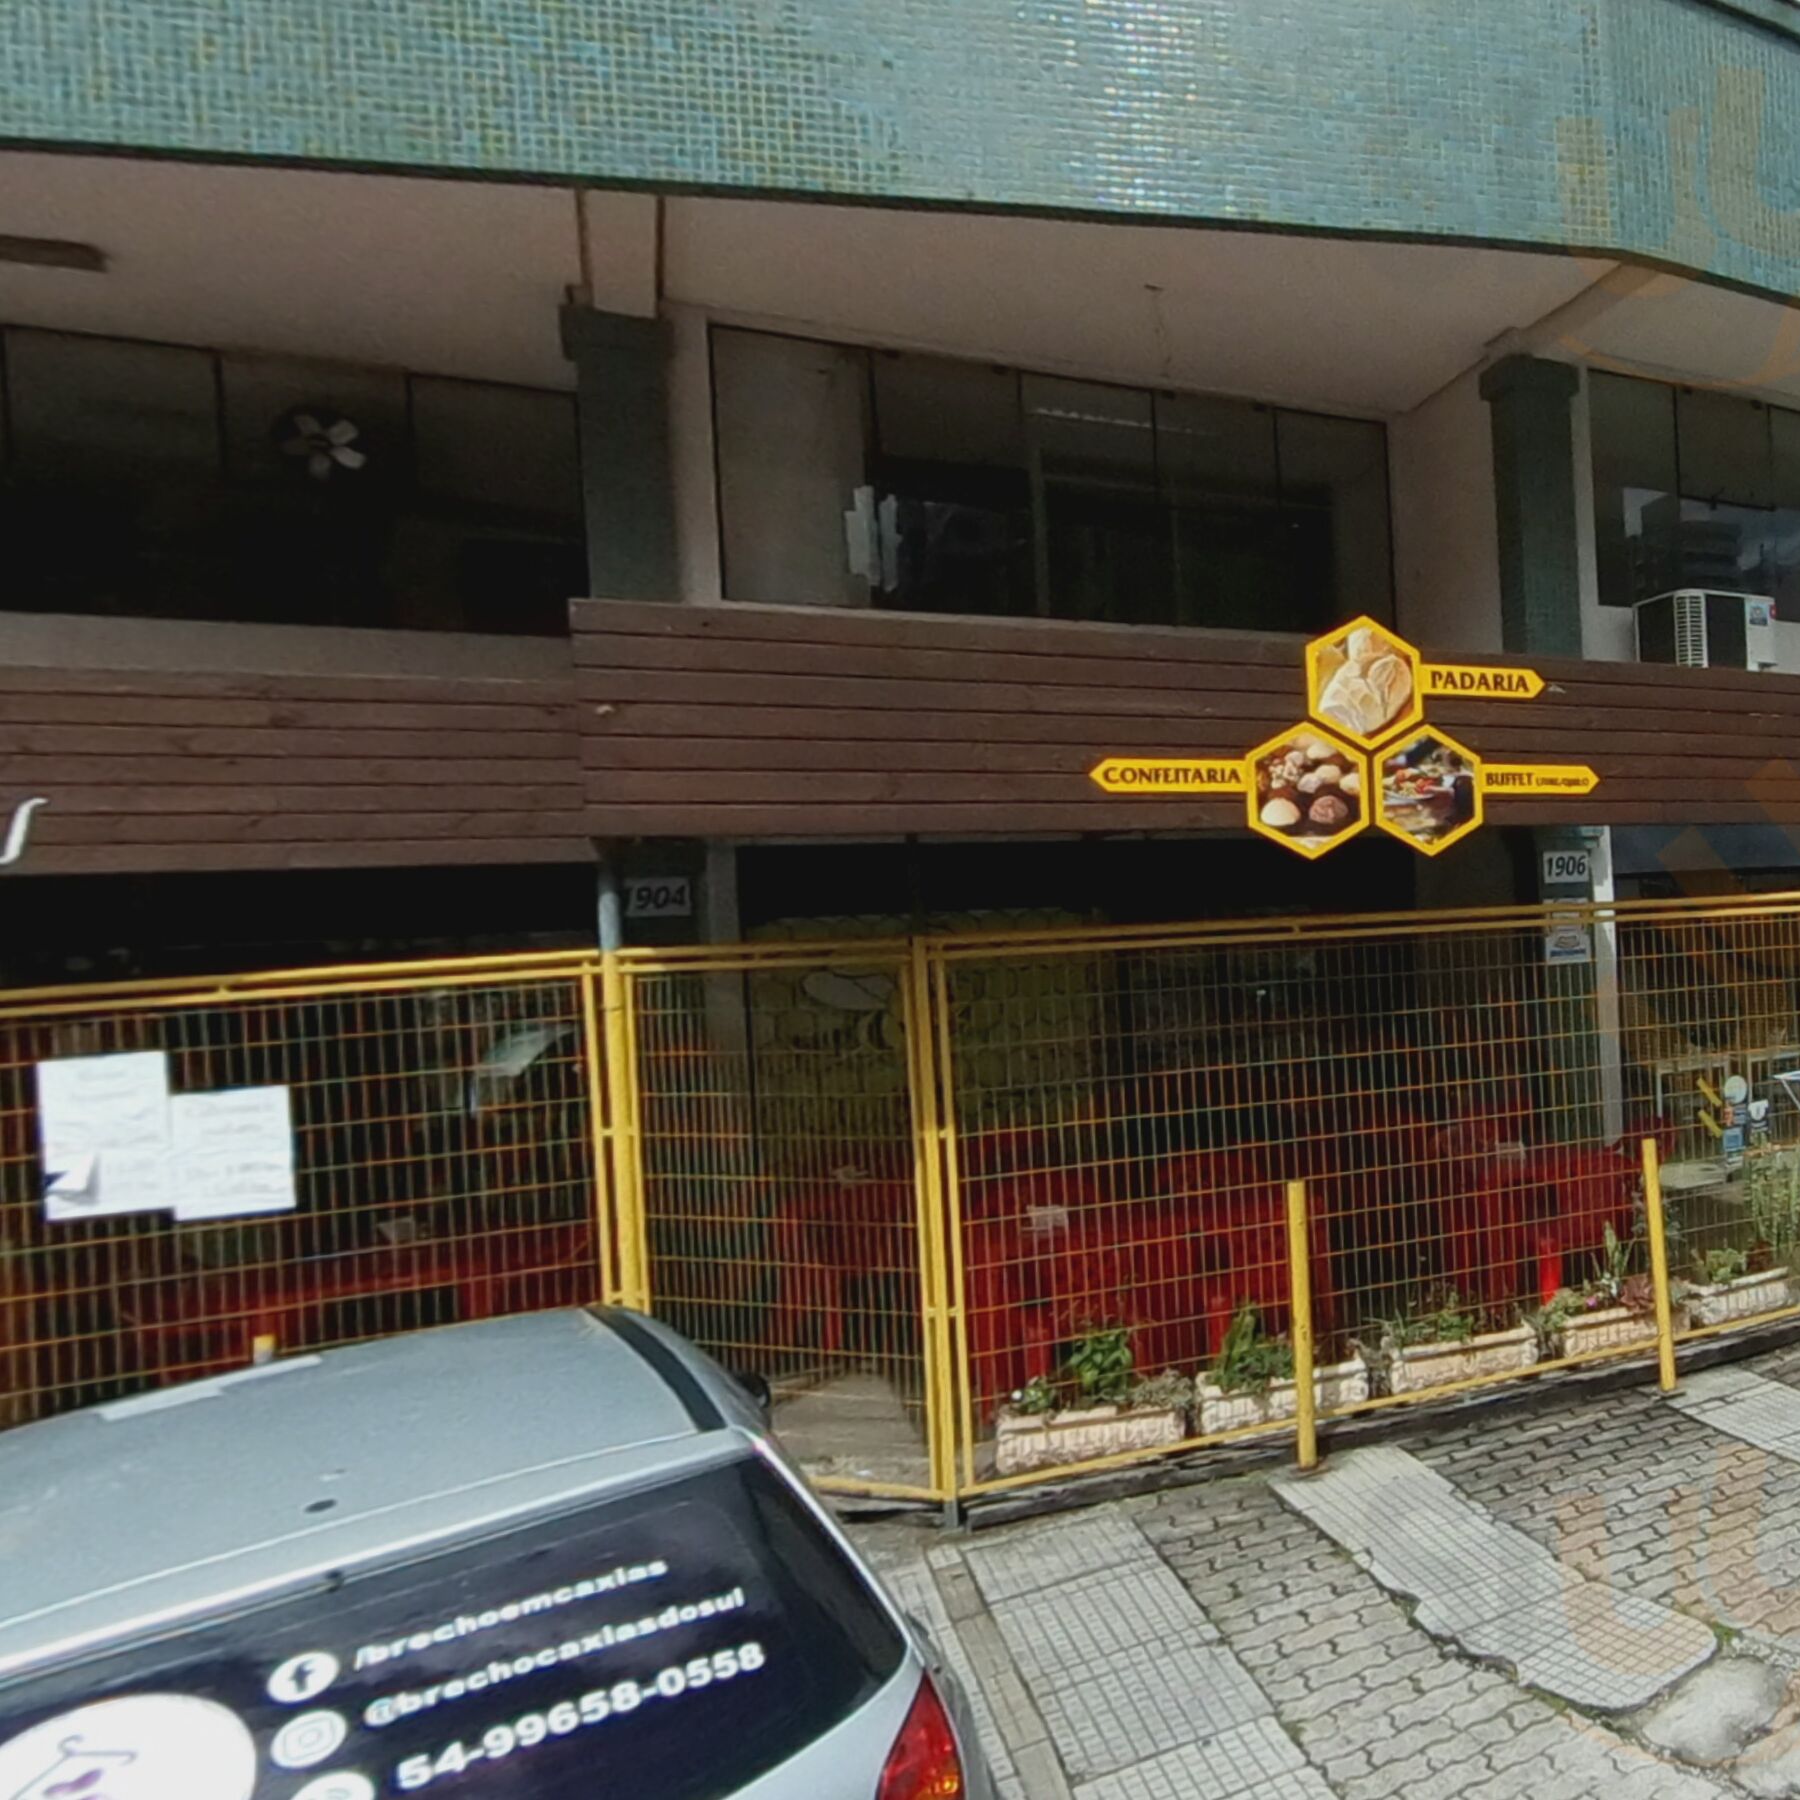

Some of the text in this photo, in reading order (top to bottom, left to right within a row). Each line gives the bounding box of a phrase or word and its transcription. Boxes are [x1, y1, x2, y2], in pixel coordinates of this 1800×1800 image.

[1430, 670, 1530, 692] PADARIA
[1103, 766, 1241, 784] CONFEITARIA
[1485, 772, 1534, 786] BUFFET
[1547, 855, 1586, 877] 1906
[364, 1586, 746, 1728] @brechocaxiasdosul
[396, 1641, 766, 1790] 54-99658-0558
